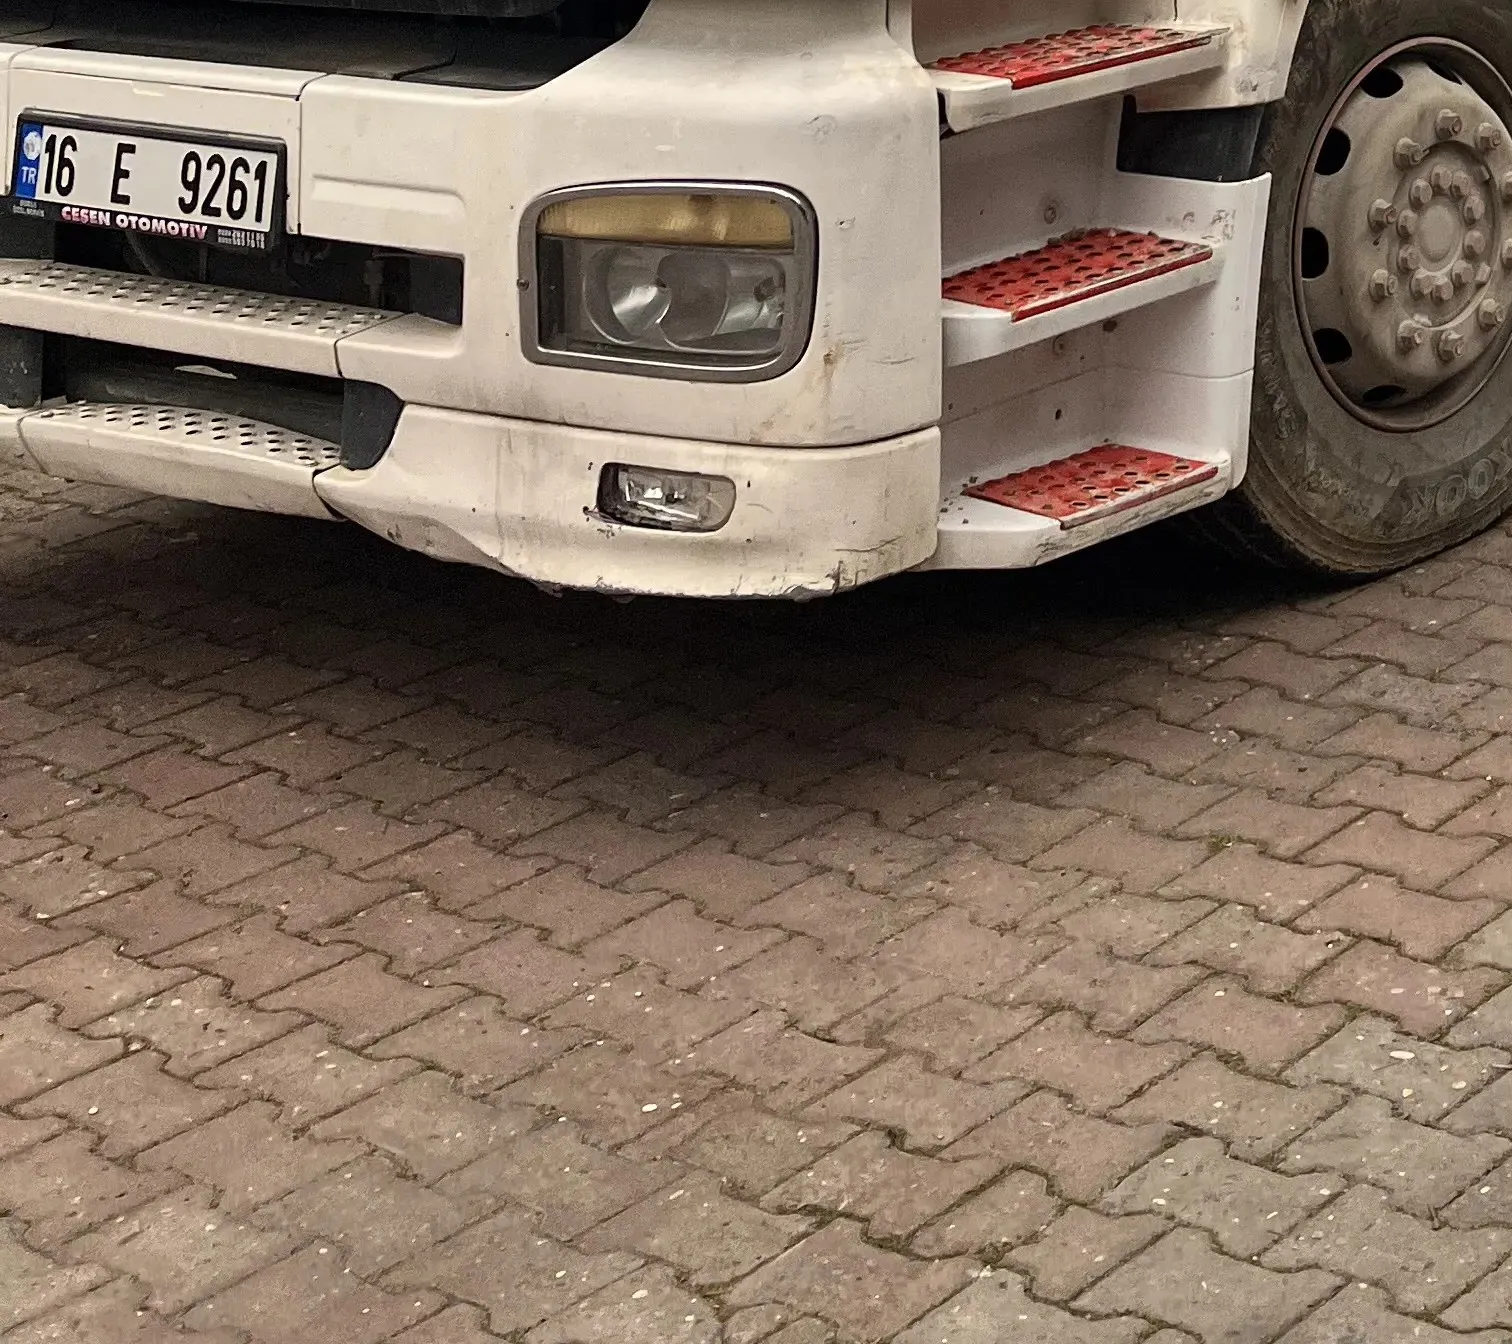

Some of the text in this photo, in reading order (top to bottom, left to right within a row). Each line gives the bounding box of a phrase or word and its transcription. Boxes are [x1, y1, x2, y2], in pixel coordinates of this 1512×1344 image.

[21, 166, 38, 184] TR
[44, 134, 268, 223] 16 E 9261
